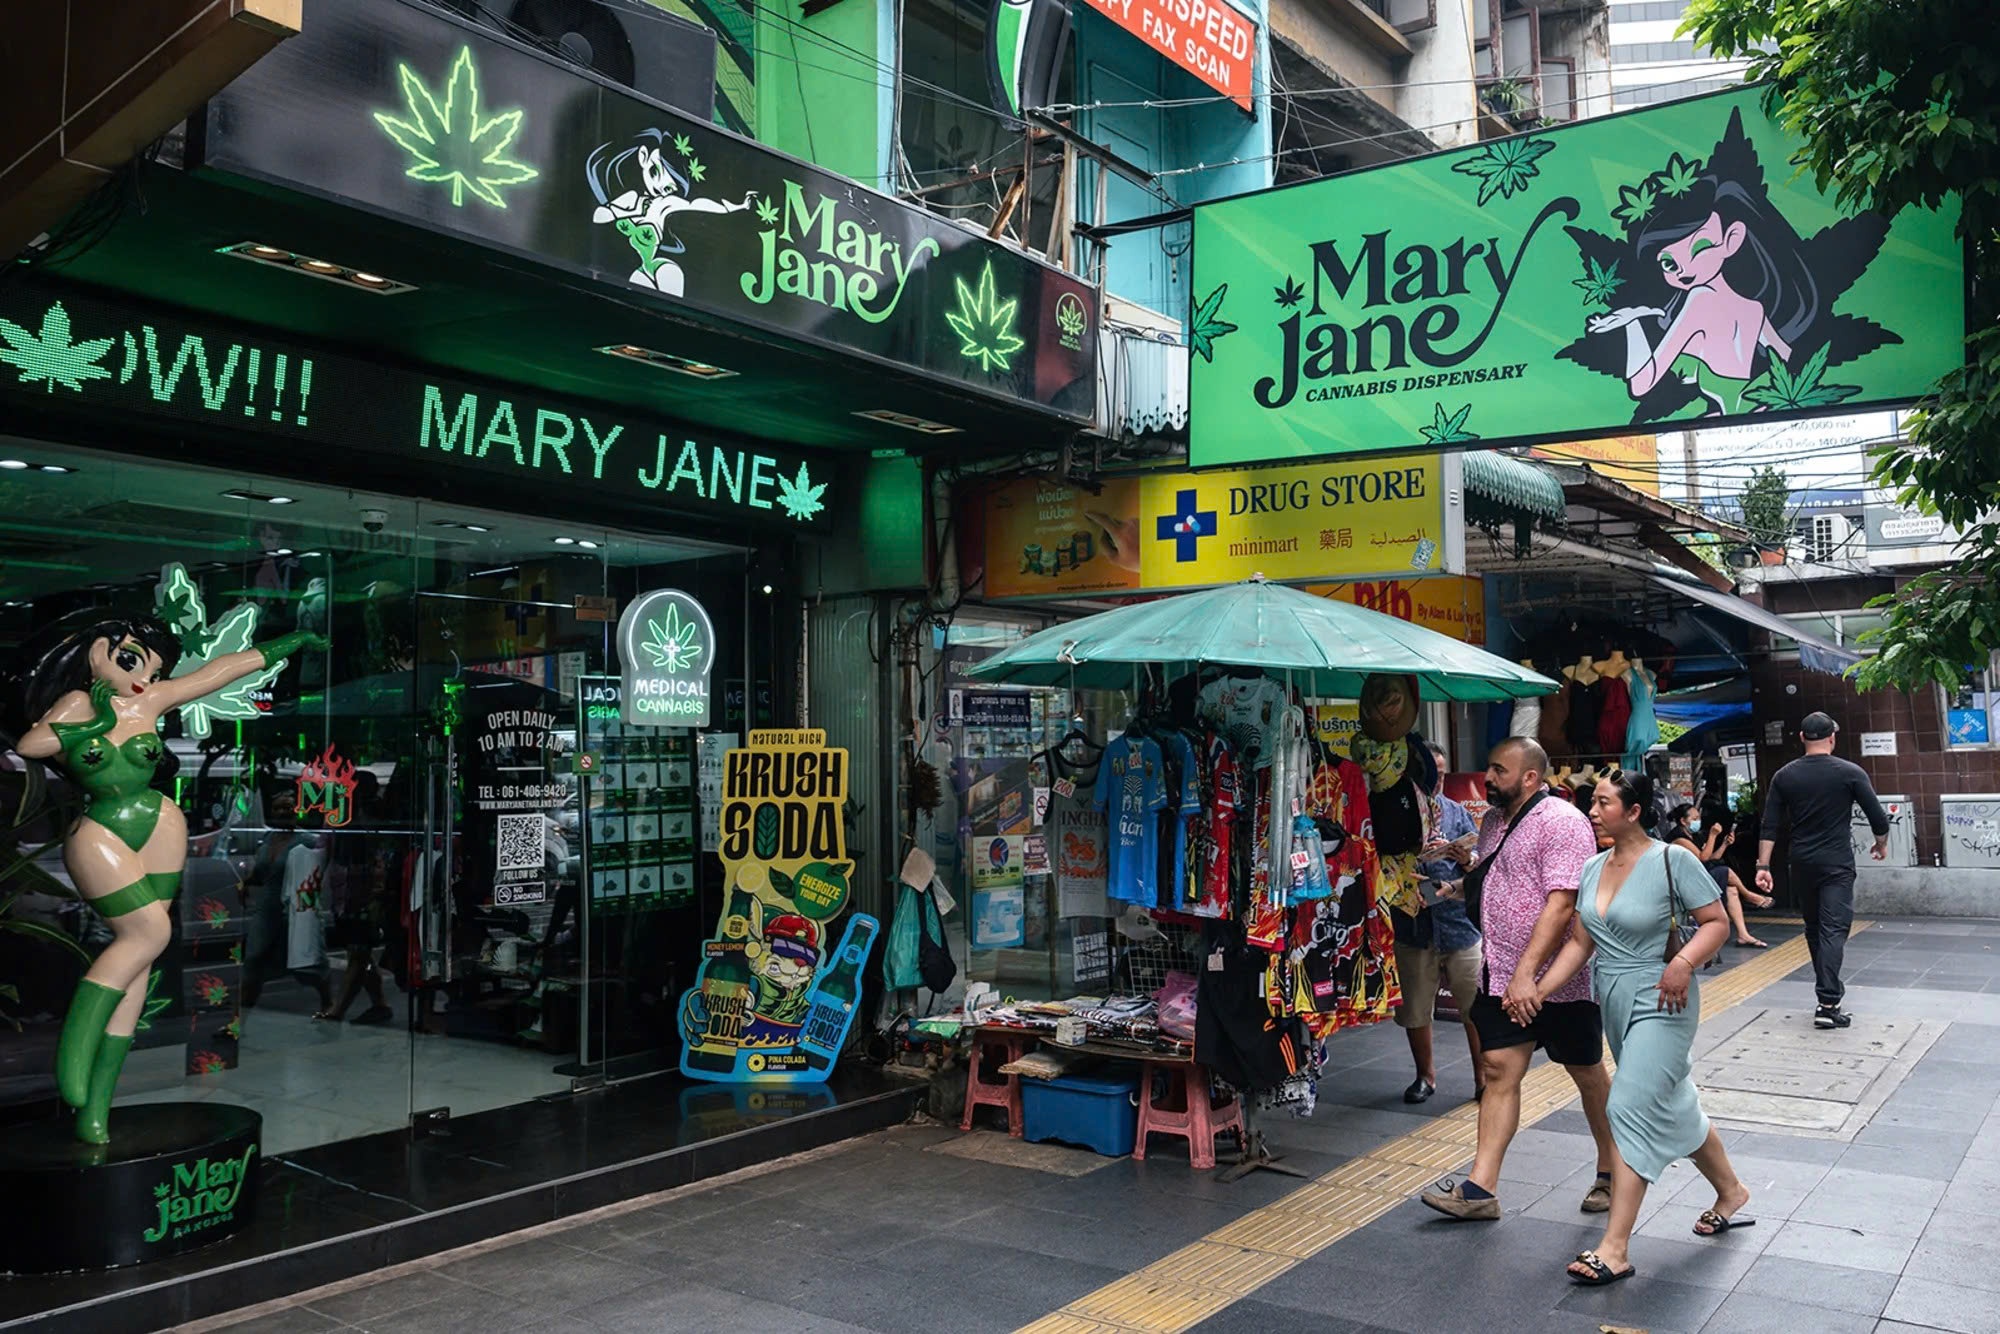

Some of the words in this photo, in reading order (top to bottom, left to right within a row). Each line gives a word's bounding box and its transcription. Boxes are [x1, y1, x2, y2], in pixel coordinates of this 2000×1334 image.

[1142, 8, 1177, 52] FAX
[1185, 38, 1230, 87] SCAN
[779, 178, 940, 290] Mary
[1305, 196, 1581, 318] Mary
[1305, 379, 1397, 402] CANNABIS
[1402, 363, 1528, 392] DISPENSARY
[420, 384, 624, 479] MARY
[638, 434, 777, 509] JANE
[1229, 480, 1309, 516] DRUG
[1321, 468, 1425, 506] STORE
[1229, 536, 1299, 556] minimart
[1320, 528, 1352, 550] 藥局
[1418, 603, 1428, 620] By
[634, 679, 708, 696] MEDICAL
[637, 698, 704, 715] CANNABIS
[488, 710, 520, 730] OPEN
[523, 710, 556, 730] DAILY
[477, 734, 495, 752] 10
[497, 731, 515, 749] AM
[518, 731, 534, 747] TO
[536, 731, 544, 748] 2
[545, 735, 566, 752] AM
[799, 733, 822, 744] HIGH
[727, 752, 842, 798] KRUSH
[478, 786, 495, 798] TEL
[502, 784, 567, 797] 061-406-9420
[1054, 779, 1073, 797] 200
[723, 801, 839, 860] SODA
[503, 870, 528, 880] FOLLOW
[529, 869, 538, 878] US
[513, 892, 543, 901] SMOKING
[799, 873, 842, 900] ENERGIZE
[800, 888, 817, 902] YOUR
[816, 895, 831, 907] DAY
[706, 942, 725, 950] HONEY
[726, 943, 744, 951] LEMON
[705, 994, 747, 1018] KRUSH
[815, 1004, 849, 1026] KRUSH
[807, 1018, 843, 1044] SODA
[783, 1055, 807, 1064] COLADA
[171, 1144, 257, 1198] Mary
